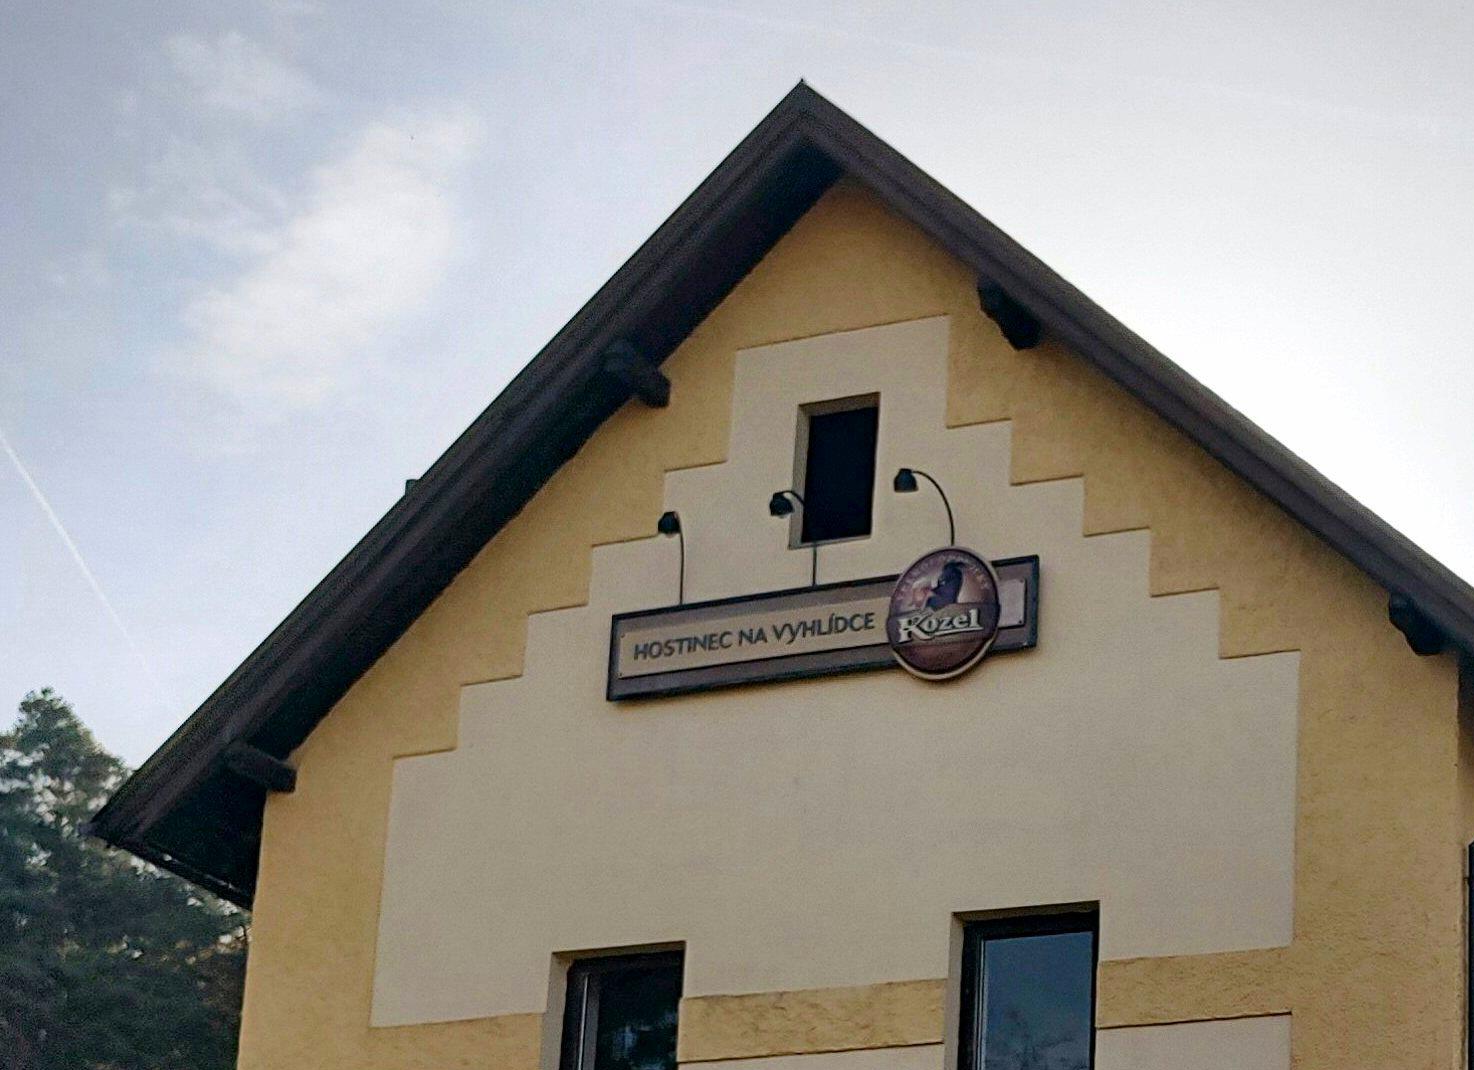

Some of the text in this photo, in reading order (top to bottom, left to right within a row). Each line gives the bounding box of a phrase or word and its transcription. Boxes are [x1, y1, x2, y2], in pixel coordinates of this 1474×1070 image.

[633, 612, 876, 661] HOSTINEC NA VYHLÍDCE
[897, 608, 984, 643] Kozel
